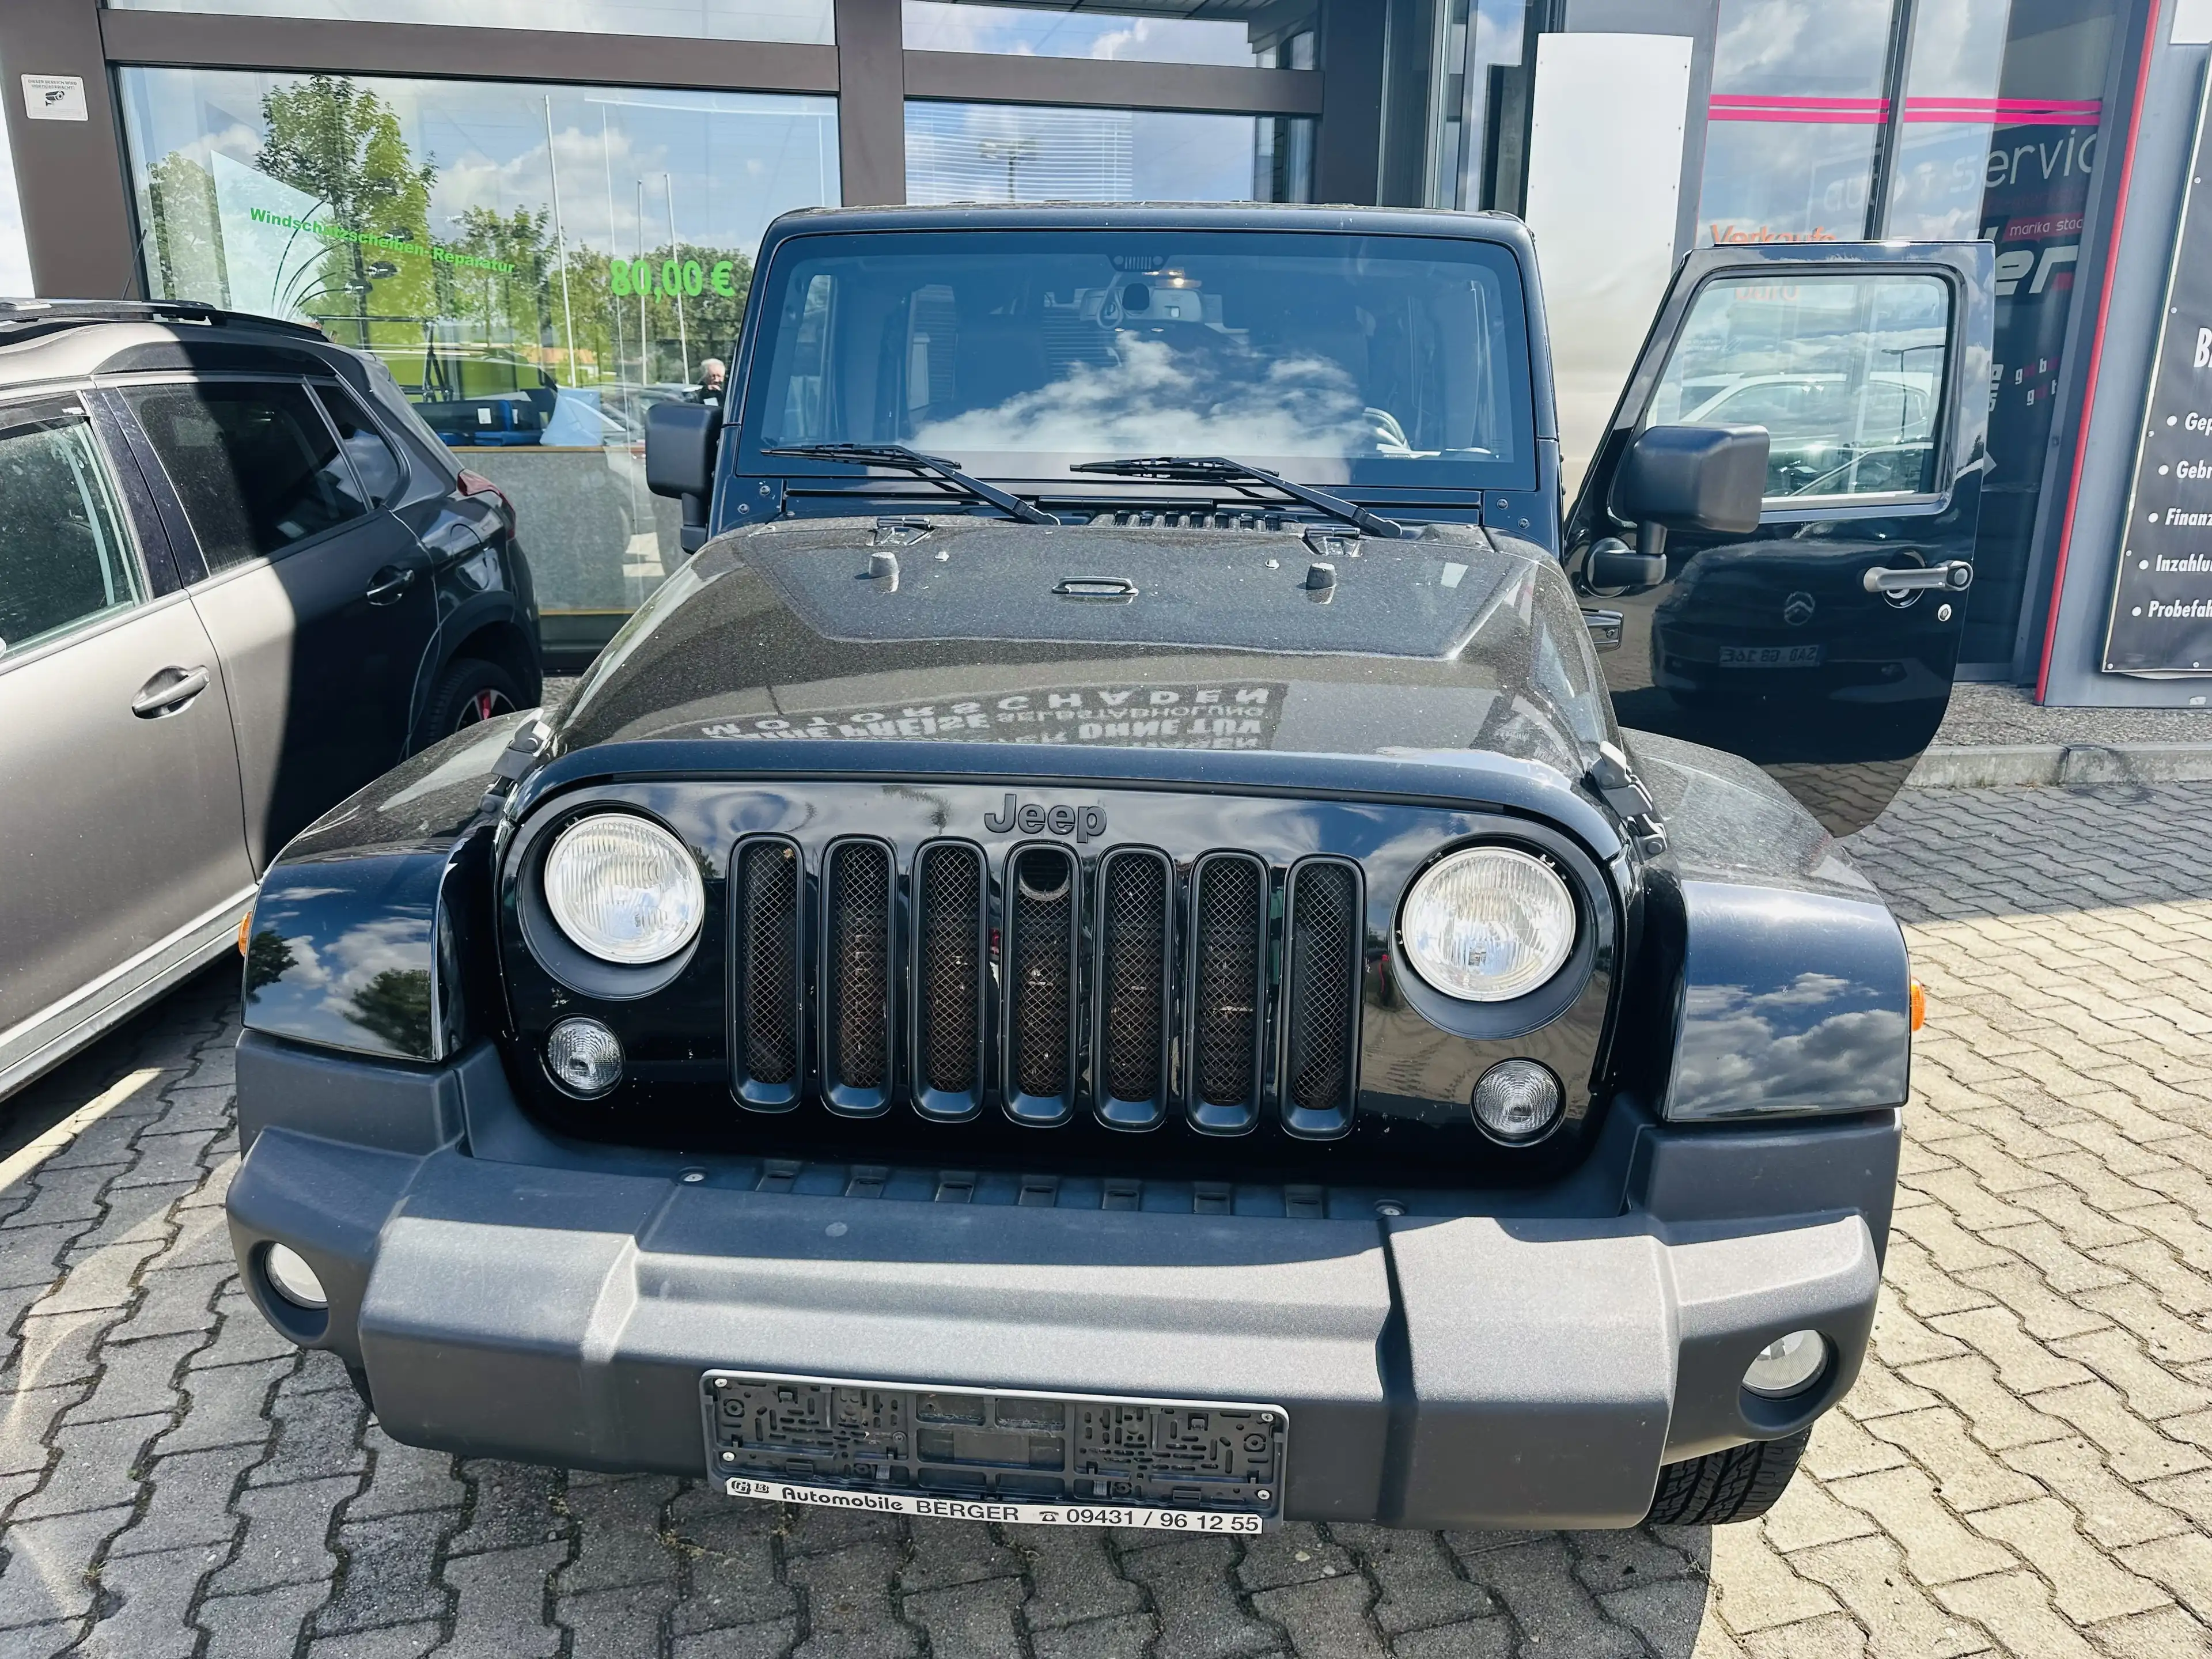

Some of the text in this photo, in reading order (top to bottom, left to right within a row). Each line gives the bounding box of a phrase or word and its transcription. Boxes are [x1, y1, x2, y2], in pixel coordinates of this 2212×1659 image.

[2010, 222, 2050, 236] marika
[610, 260, 736, 304] 80,00 €
[2194, 327, 2212, 368] B
[2184, 412, 2212, 436] Gep
[984, 793, 1107, 843] Jeep
[782, 1487, 903, 1510] Automobile
[916, 1500, 1018, 1520] BERGER
[1067, 1509, 1133, 1525] 09431
[1143, 1511, 1153, 1525] /
[1160, 1512, 1187, 1528] 96
[1197, 1515, 1223, 1530] 12
[1231, 1517, 1259, 1531] 55
